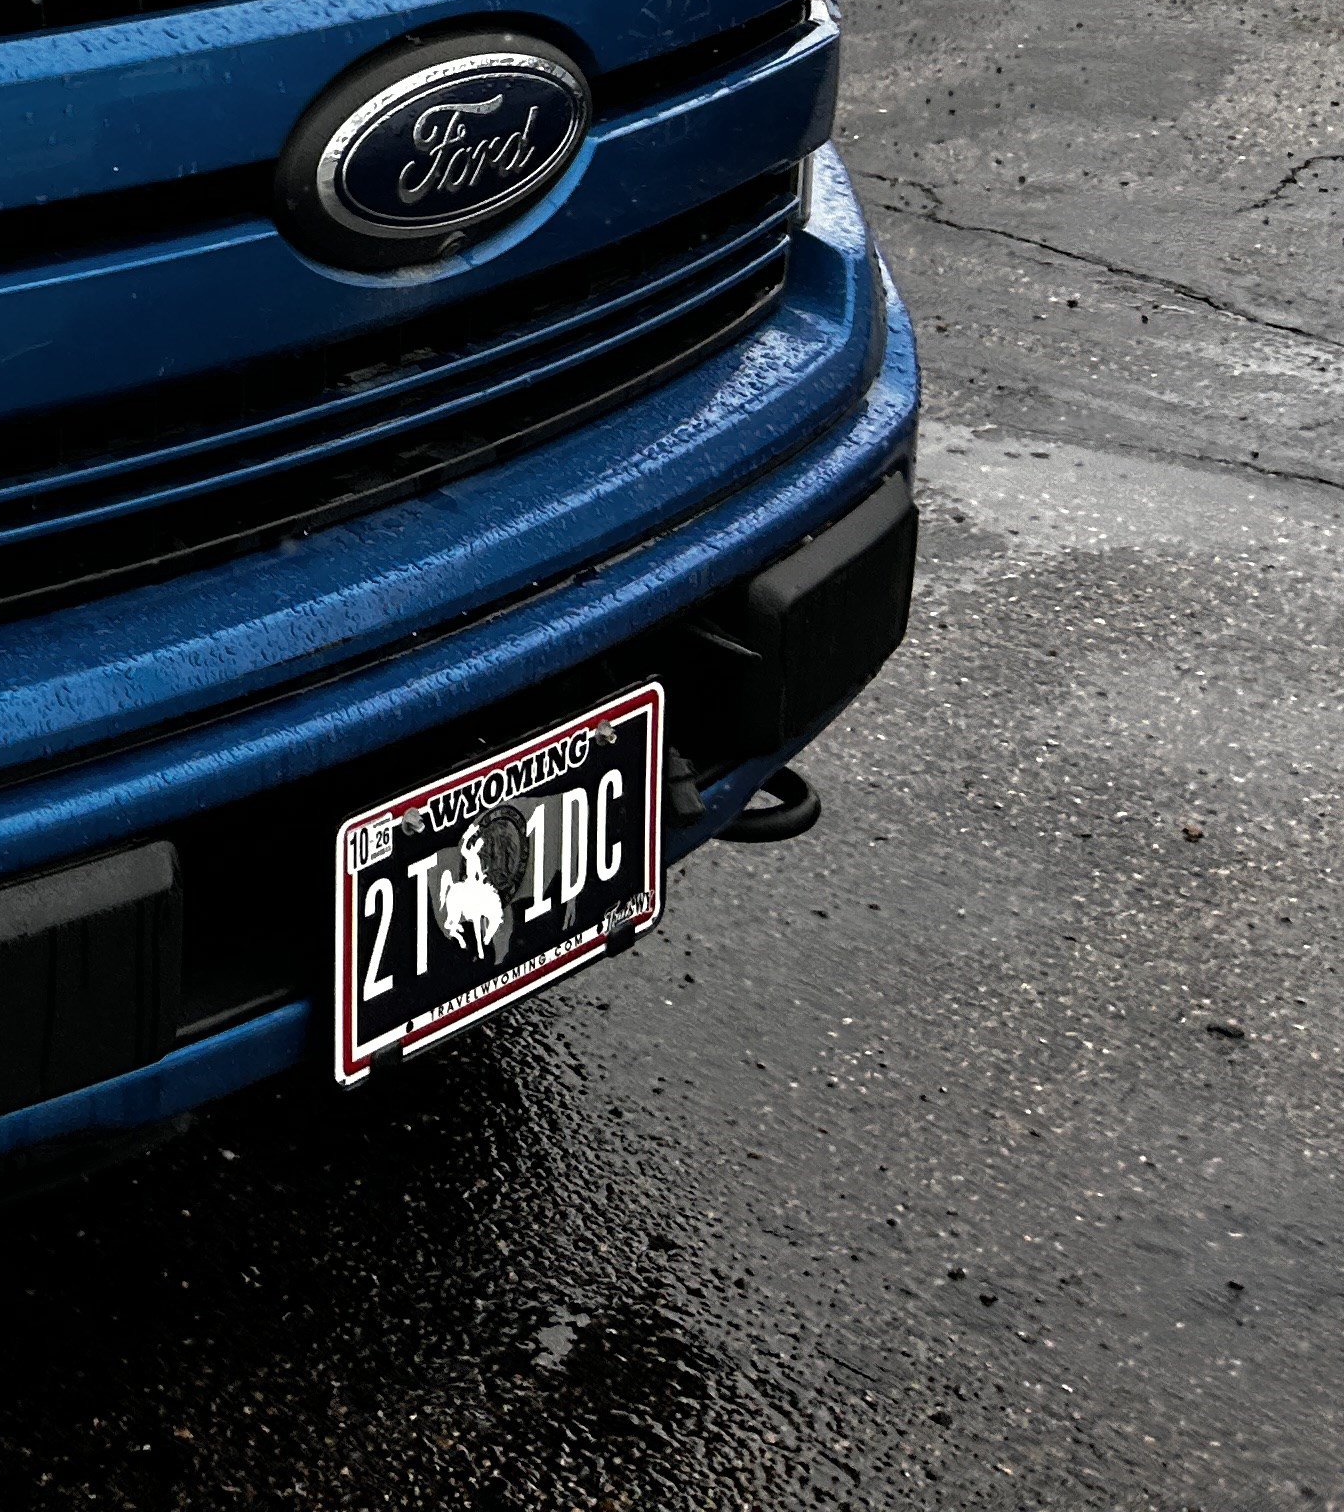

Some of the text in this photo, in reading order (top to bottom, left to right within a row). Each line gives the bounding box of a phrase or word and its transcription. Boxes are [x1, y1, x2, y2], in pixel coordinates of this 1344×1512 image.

[399, 94, 538, 204] Ford
[427, 727, 590, 832] WYOMING
[350, 828, 368, 869] 10
[375, 827, 390, 848] 26
[524, 769, 623, 923] 1DC
[429, 933, 583, 1021] TRAVELWYOMING.COM
